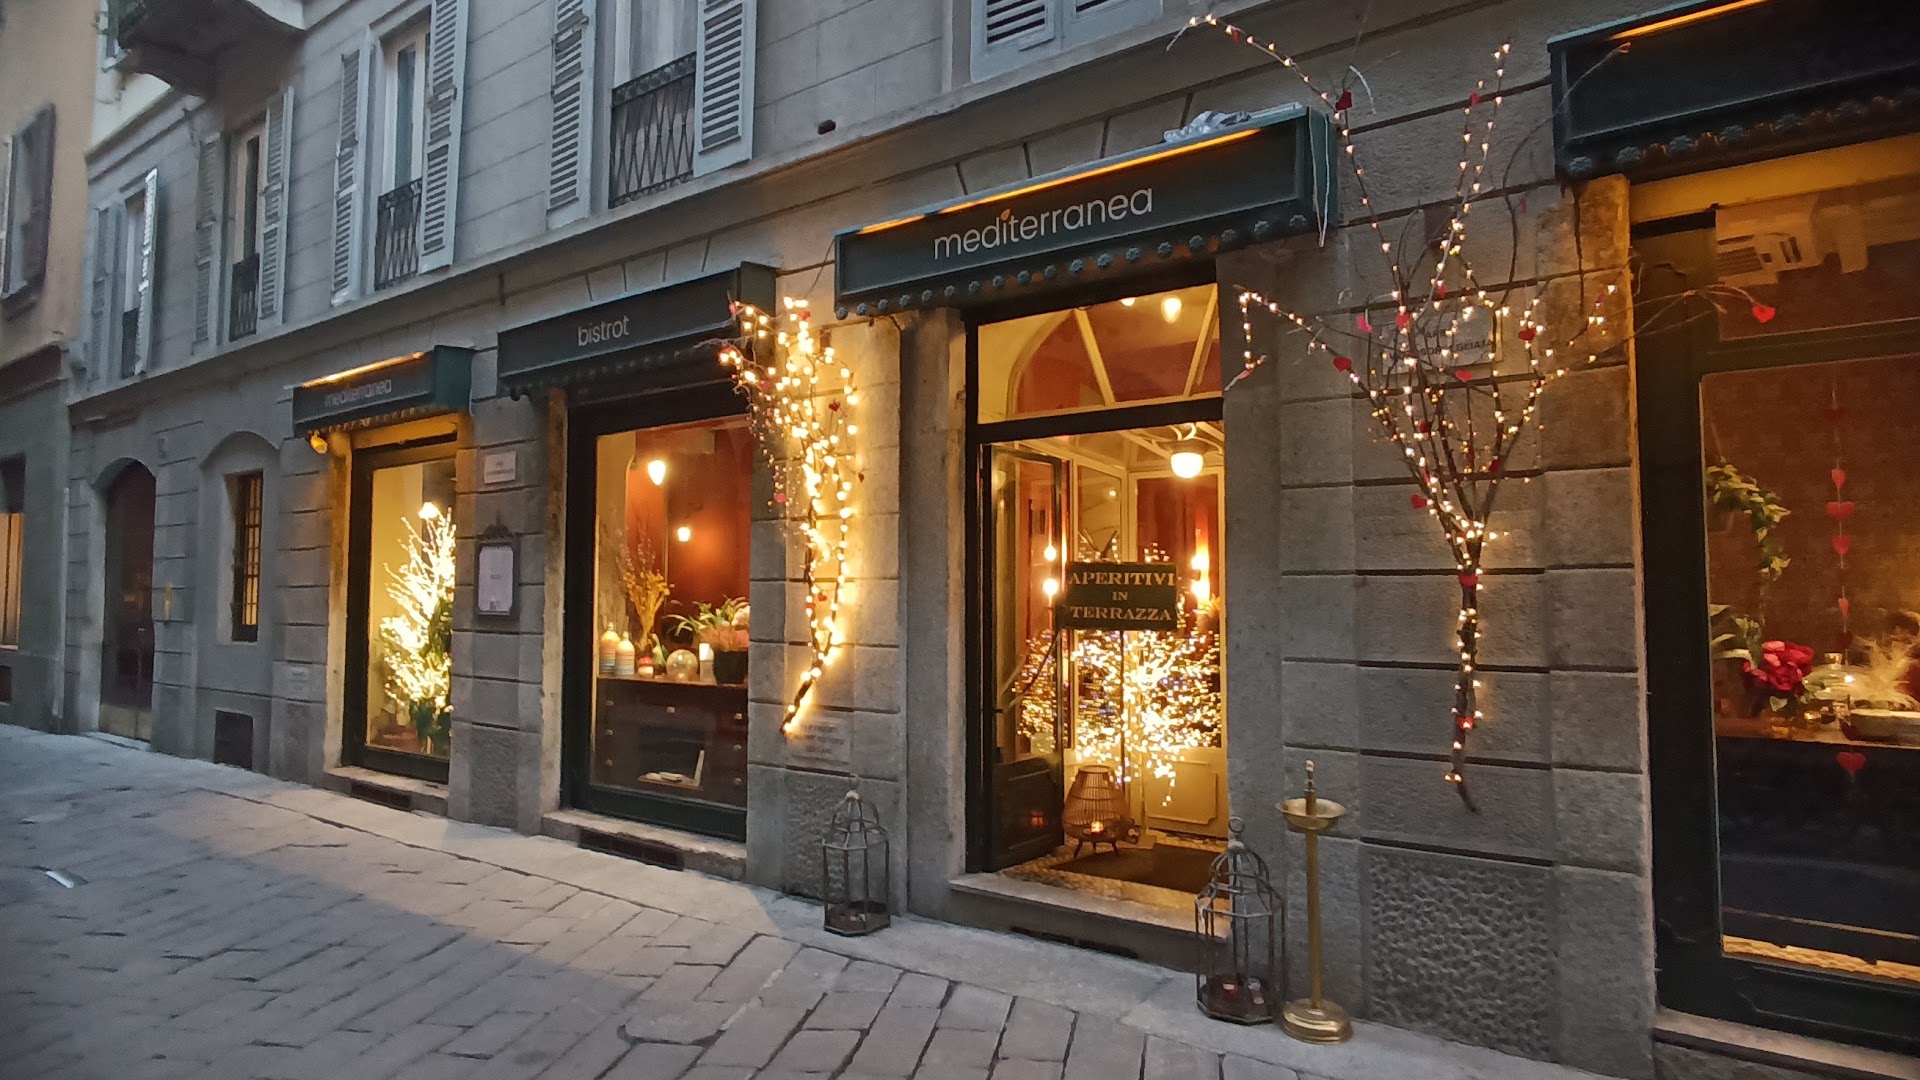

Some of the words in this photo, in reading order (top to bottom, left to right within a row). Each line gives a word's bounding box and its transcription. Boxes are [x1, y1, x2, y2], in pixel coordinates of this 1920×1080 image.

[934, 187, 1152, 260] mediterranea
[577, 316, 630, 346] bistrot
[1068, 571, 1175, 587] APERITIVI
[1112, 591, 1128, 601] IN
[1069, 606, 1172, 621] TERRAZZA
